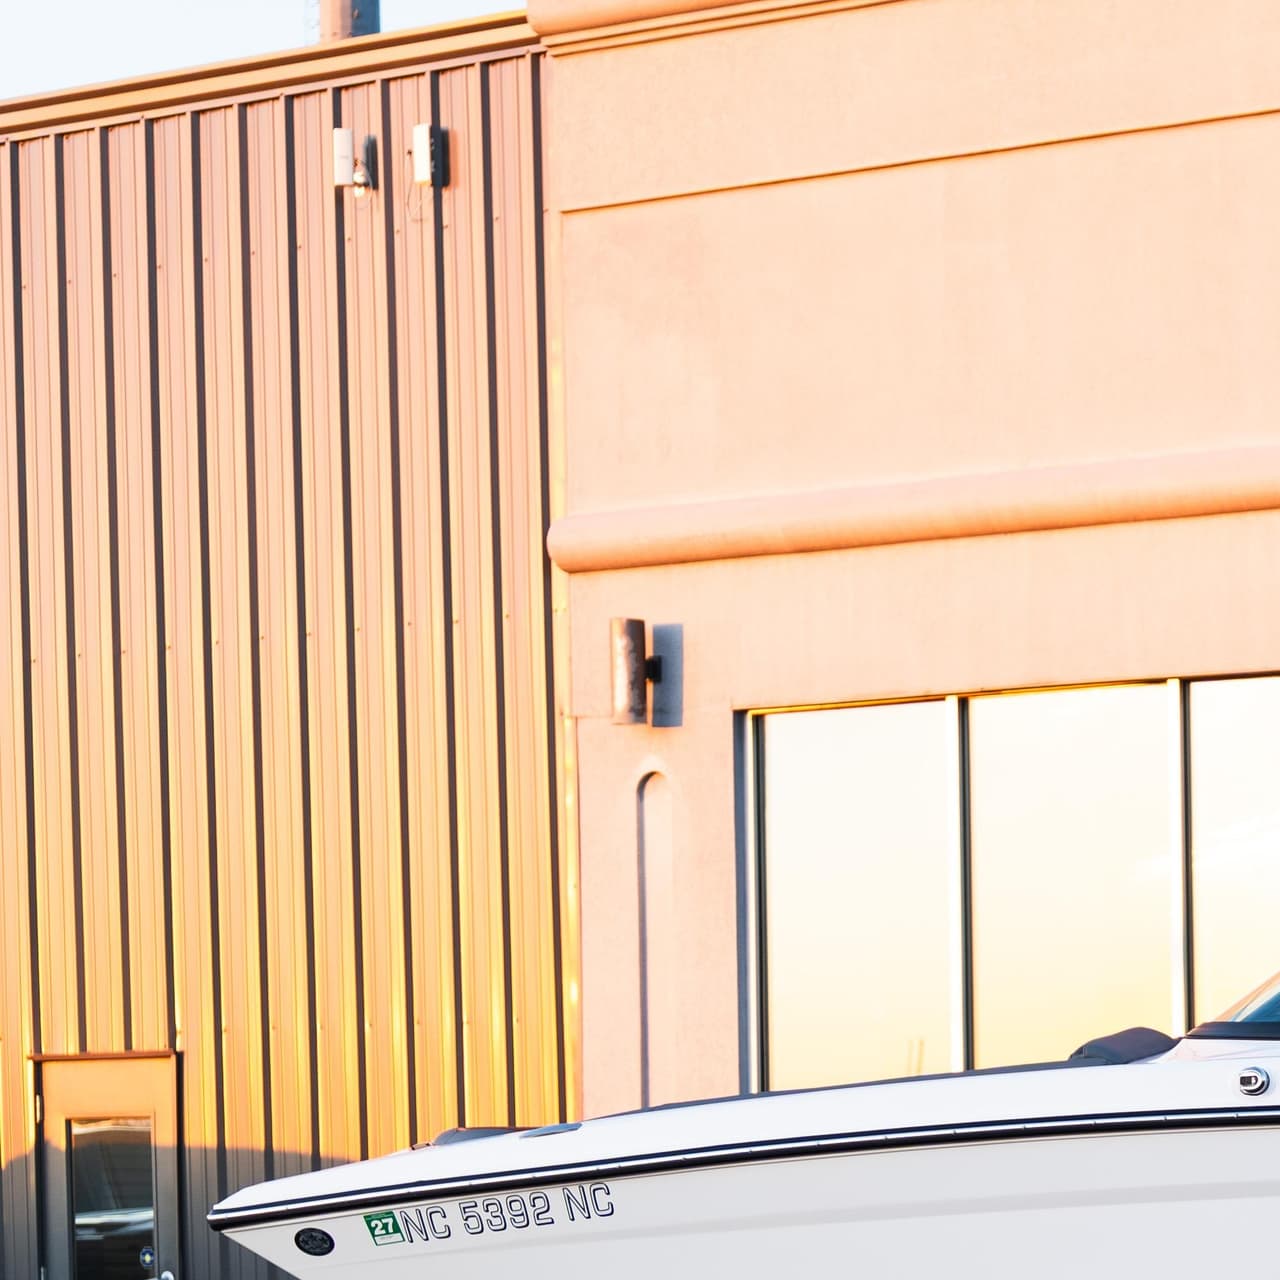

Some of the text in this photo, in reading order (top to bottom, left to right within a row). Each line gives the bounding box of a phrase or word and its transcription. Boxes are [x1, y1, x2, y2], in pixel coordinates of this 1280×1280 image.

[370, 1217, 394, 1236] 27
[400, 1183, 614, 1243] NC 5392 NC
